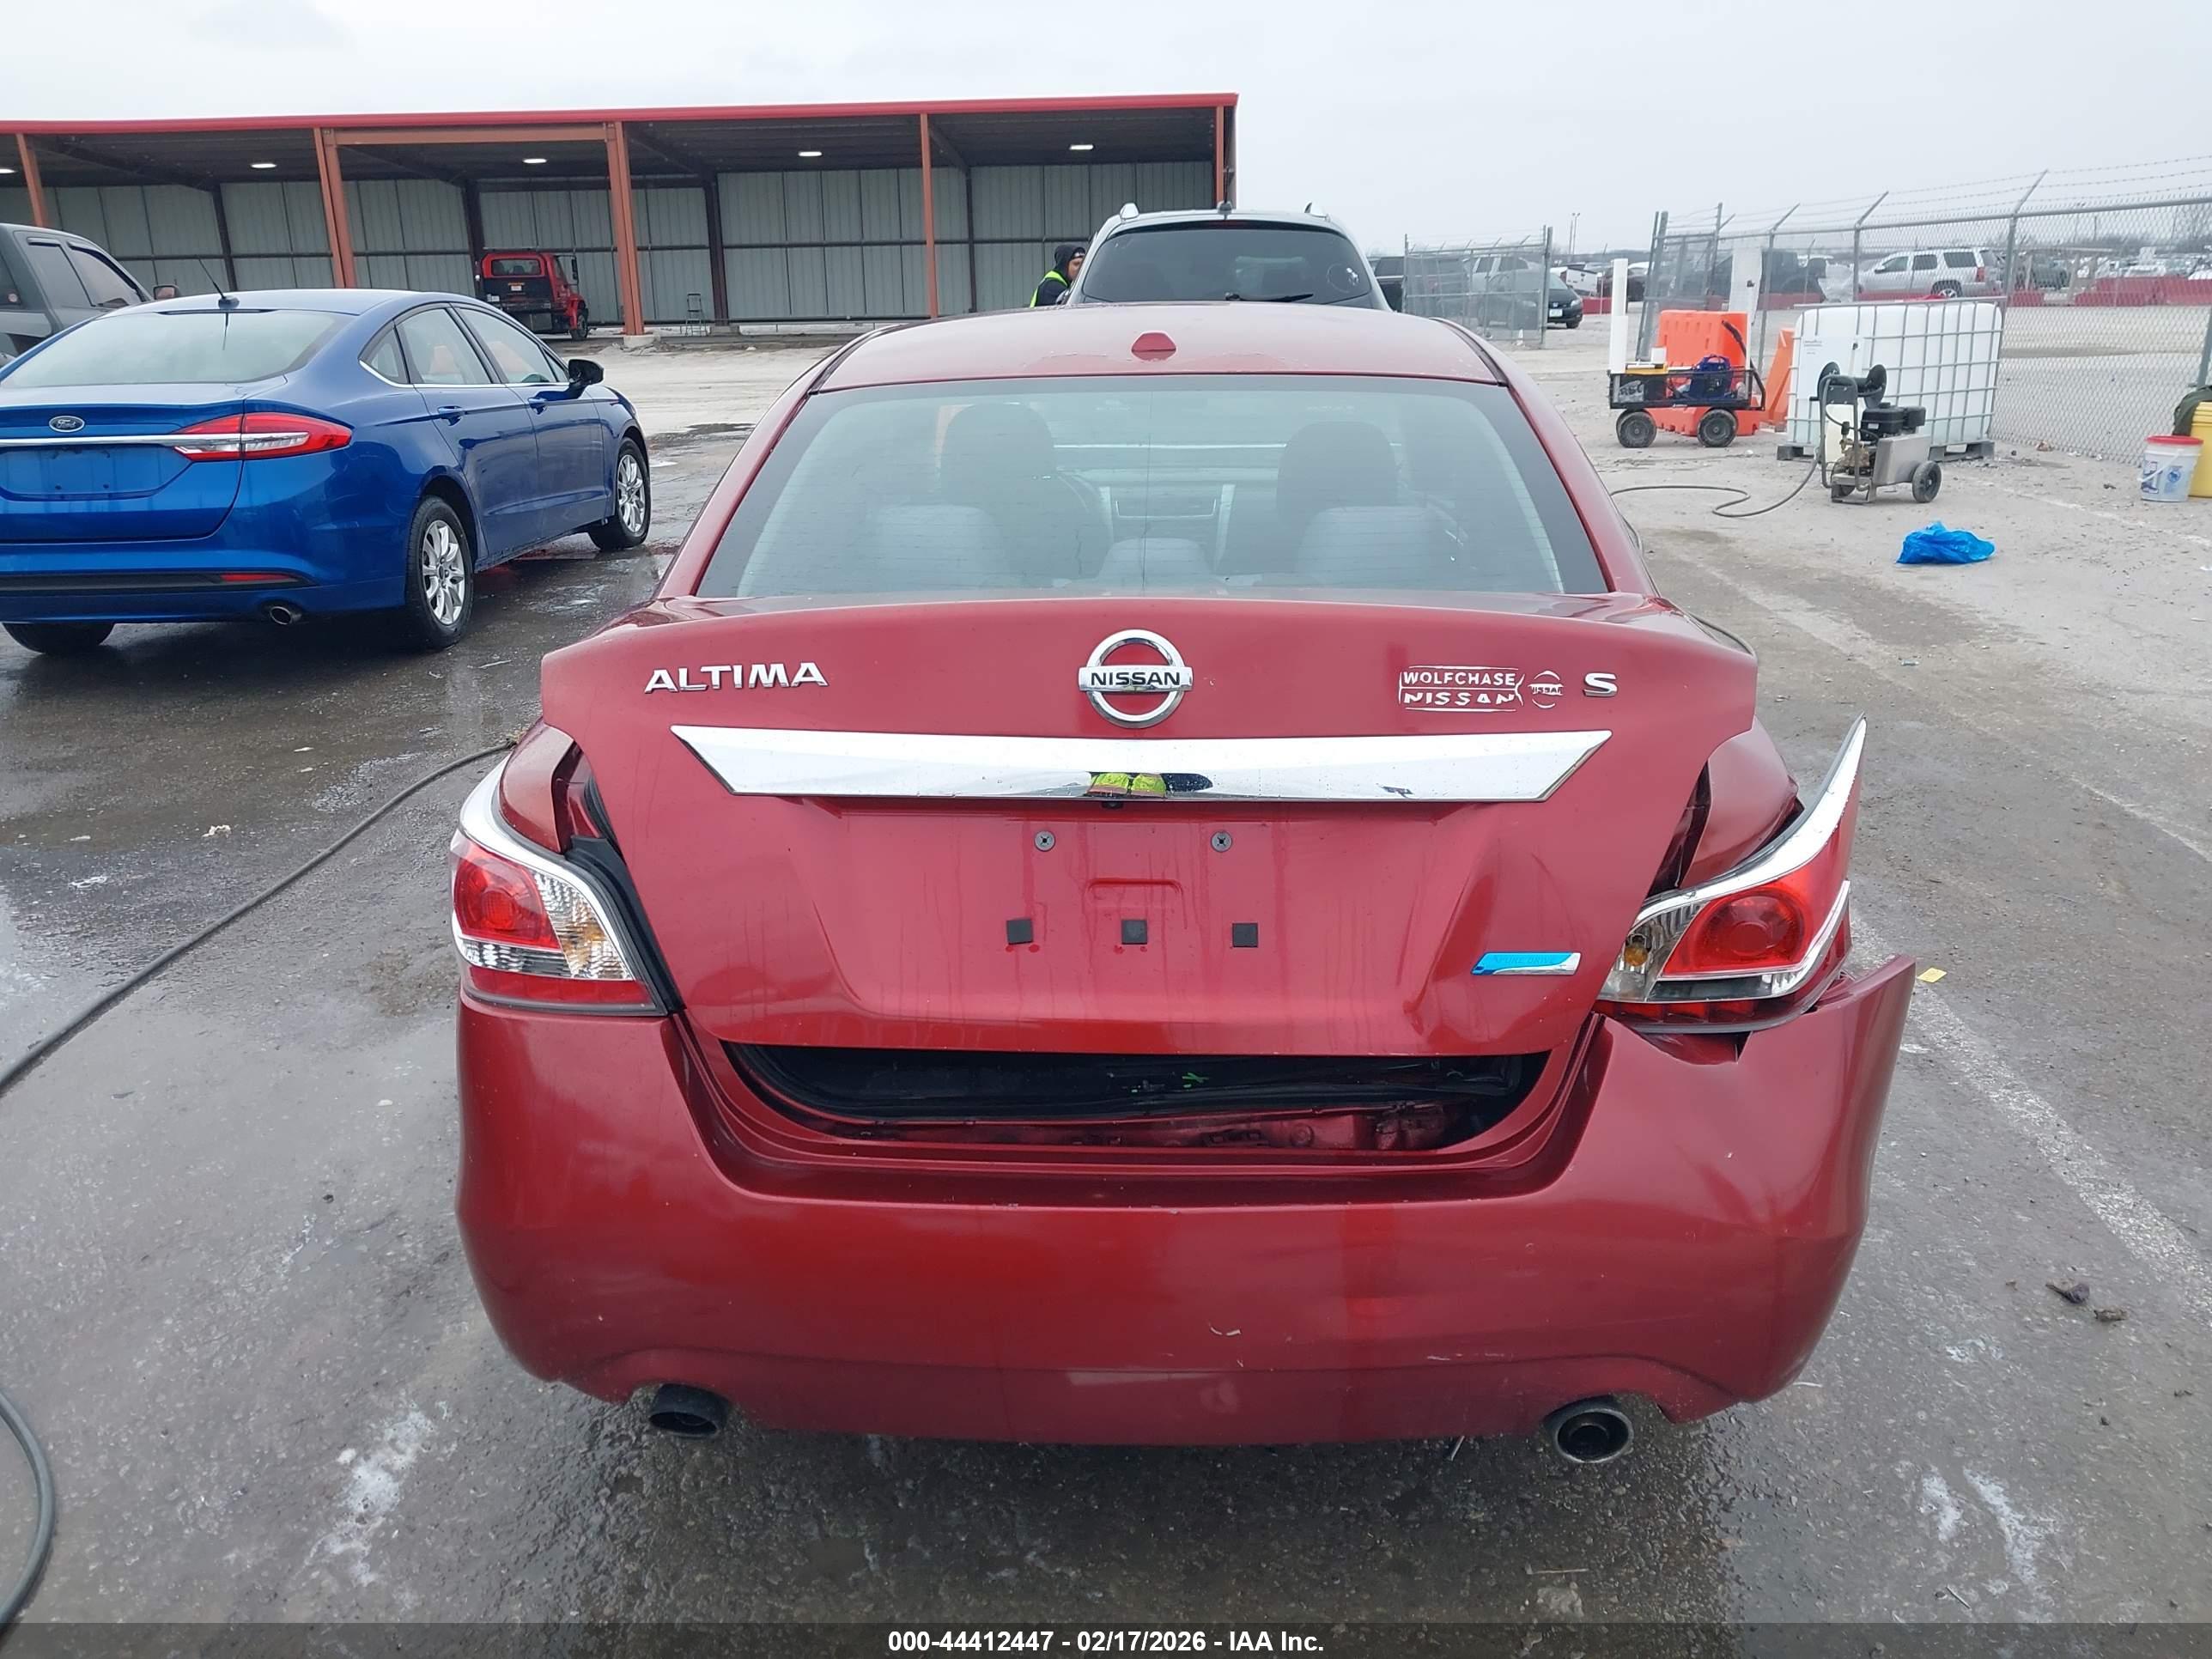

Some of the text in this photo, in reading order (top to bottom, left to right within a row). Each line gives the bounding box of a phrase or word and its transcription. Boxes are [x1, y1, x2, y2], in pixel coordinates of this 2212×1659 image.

[644, 662, 829, 694] ALTIMA
[1090, 669, 1182, 687] NISSAN
[1403, 671, 1516, 686] WOLFCHASE
[1583, 672, 1618, 697] S
[1403, 692, 1516, 706] NISSAN
